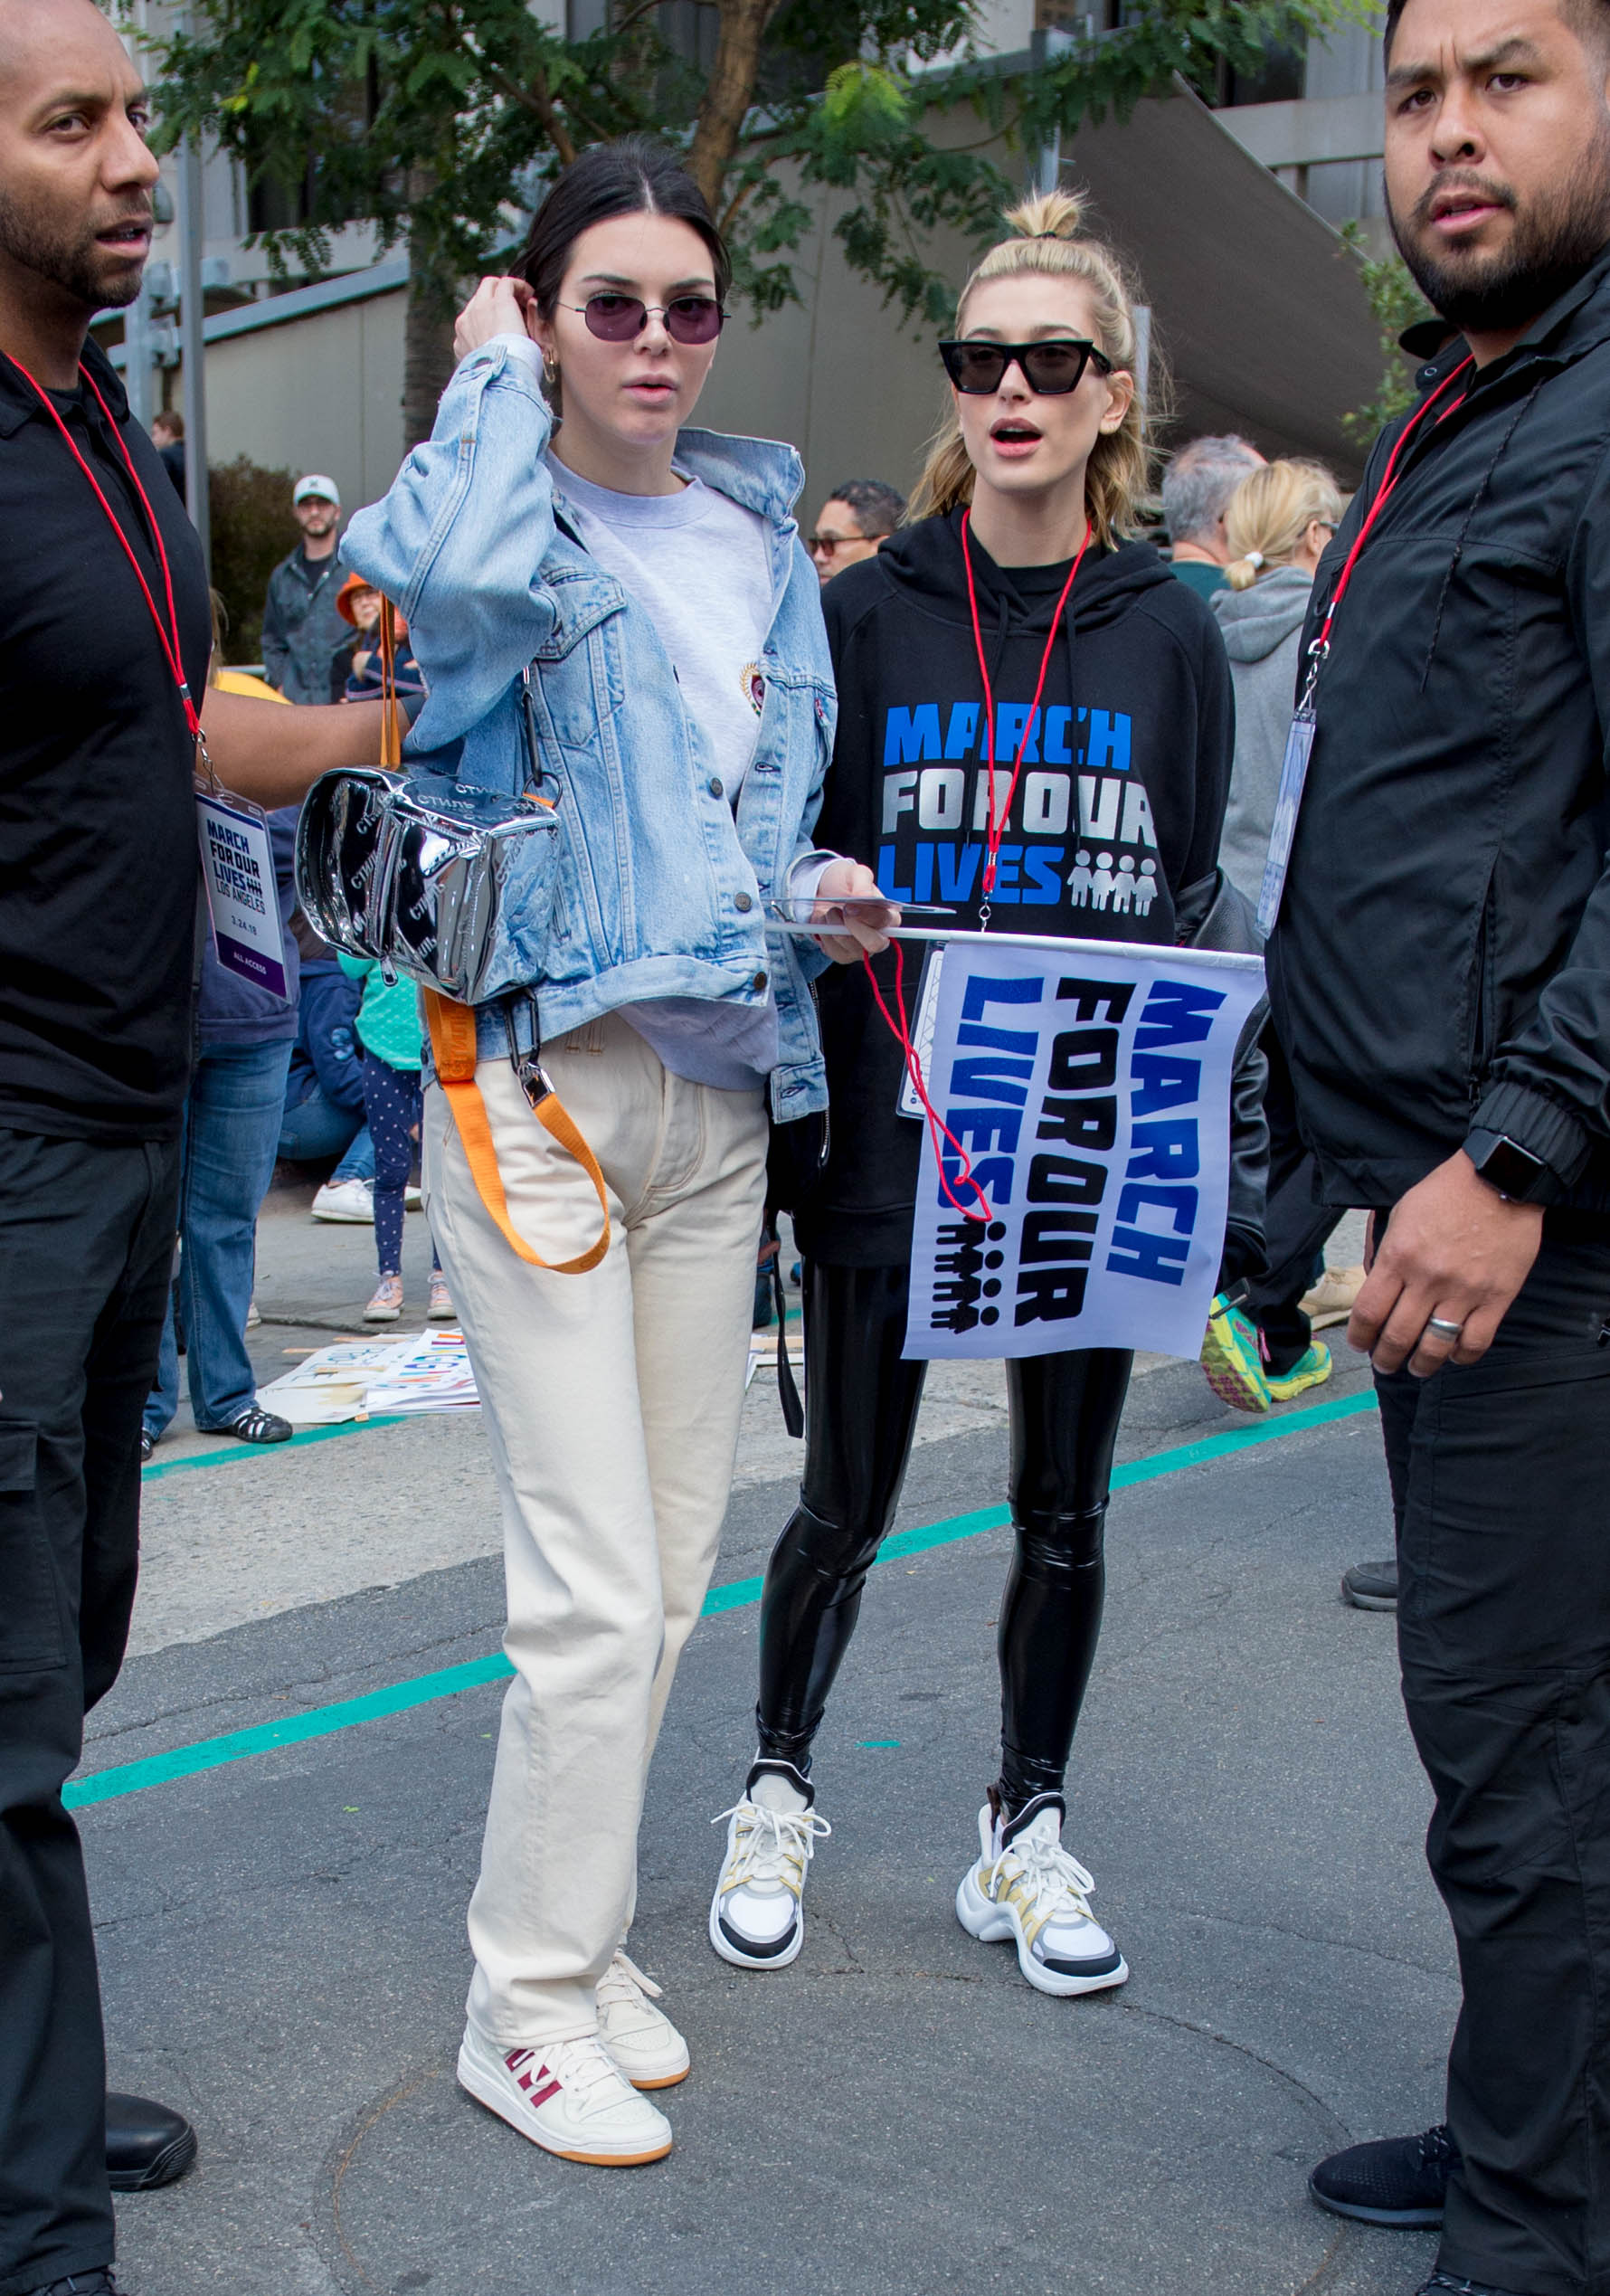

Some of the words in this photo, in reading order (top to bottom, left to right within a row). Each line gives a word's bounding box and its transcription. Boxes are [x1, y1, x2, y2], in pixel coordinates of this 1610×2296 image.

[883, 701, 1132, 771] MARCH
[207, 819, 250, 854] MARCH
[882, 768, 1011, 834] FOR
[1022, 771, 1158, 849] OUR
[210, 840, 235, 867] FOR
[235, 851, 260, 878] OUR
[213, 860, 247, 891] LIVES
[877, 842, 1065, 906] LIVES
[215, 878, 231, 898] LOS
[232, 887, 266, 916] ANGELES
[231, 915, 258, 936] 3.24.18
[233, 951, 244, 964] ALL
[244, 956, 268, 975] ACCESS
[937, 974, 1045, 1209] LIVES
[1036, 976, 1137, 1151] FOR
[1106, 980, 1228, 1286] MARCH
[1014, 1153, 1108, 1327] OUR
